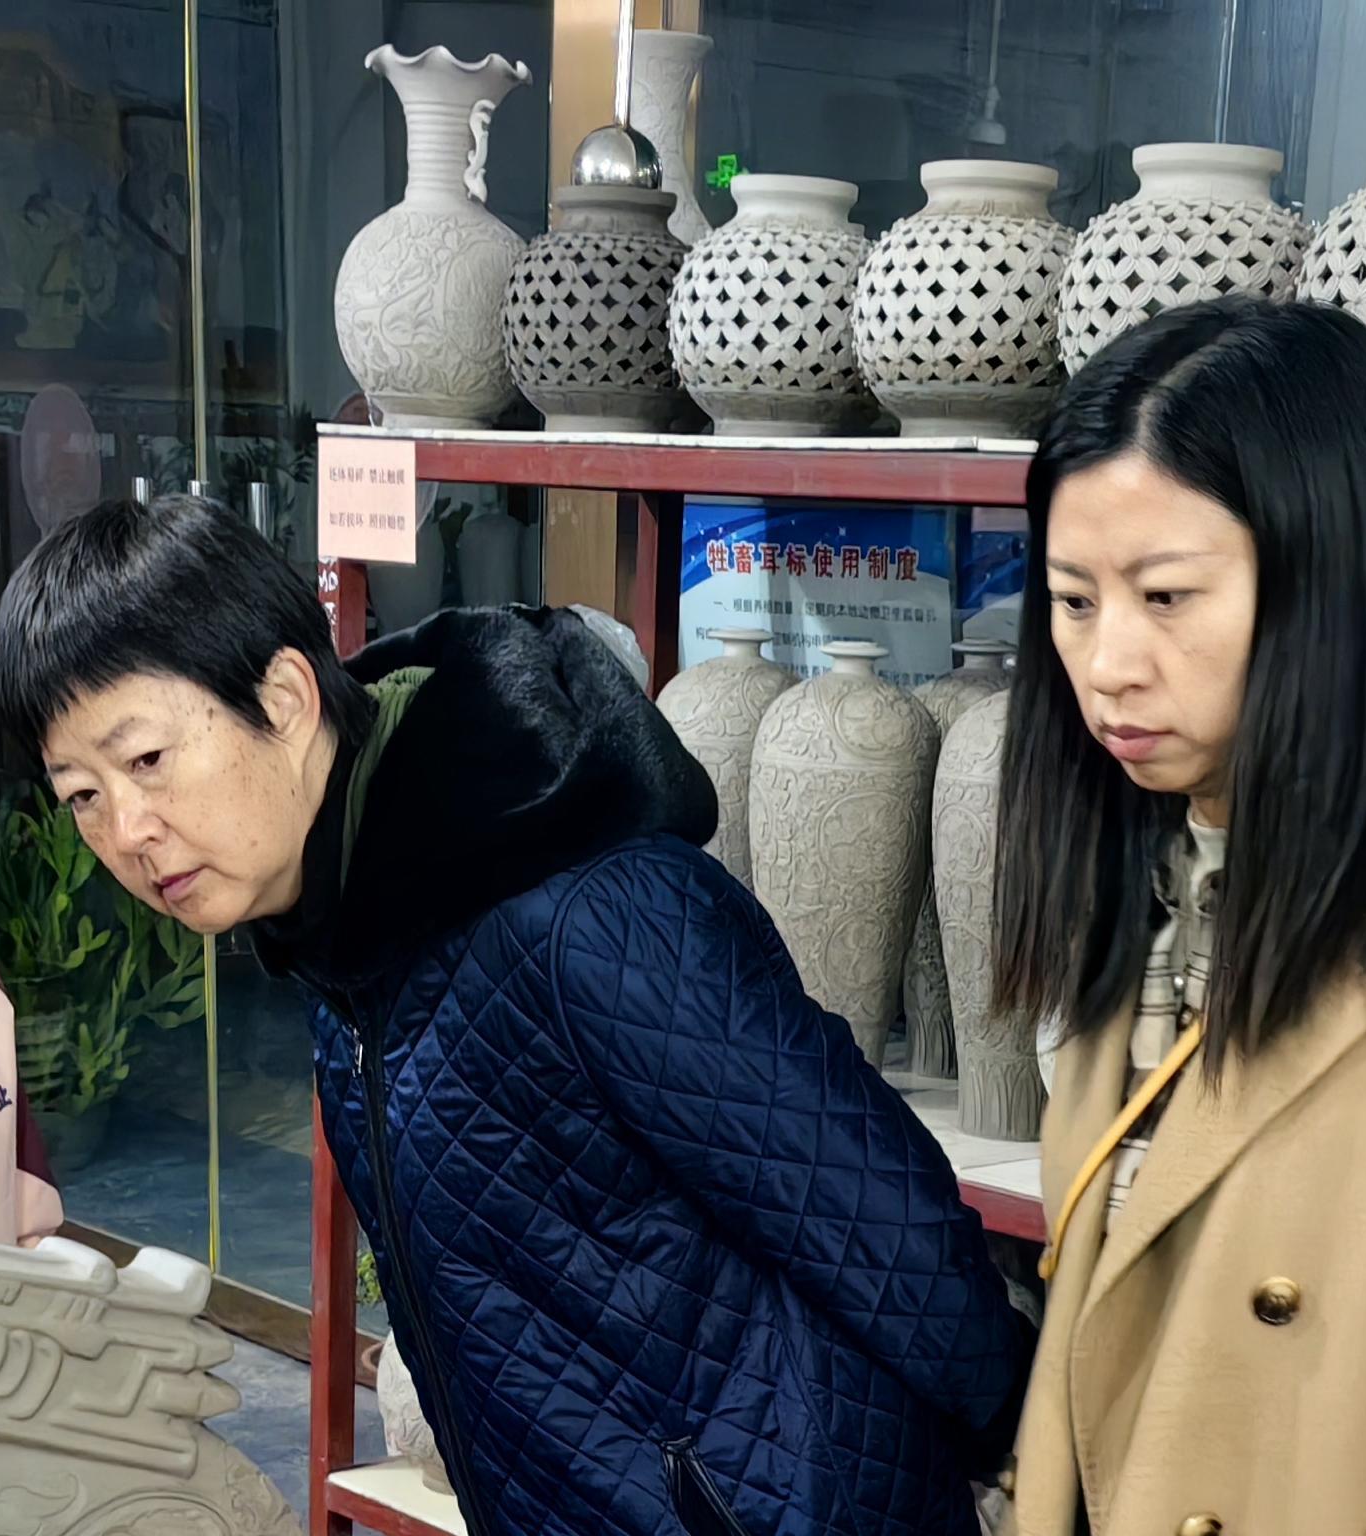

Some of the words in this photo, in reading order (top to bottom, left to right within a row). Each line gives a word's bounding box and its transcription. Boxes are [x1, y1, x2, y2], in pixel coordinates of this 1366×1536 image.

[706, 539, 920, 582] 牲畜耳标使用制度
